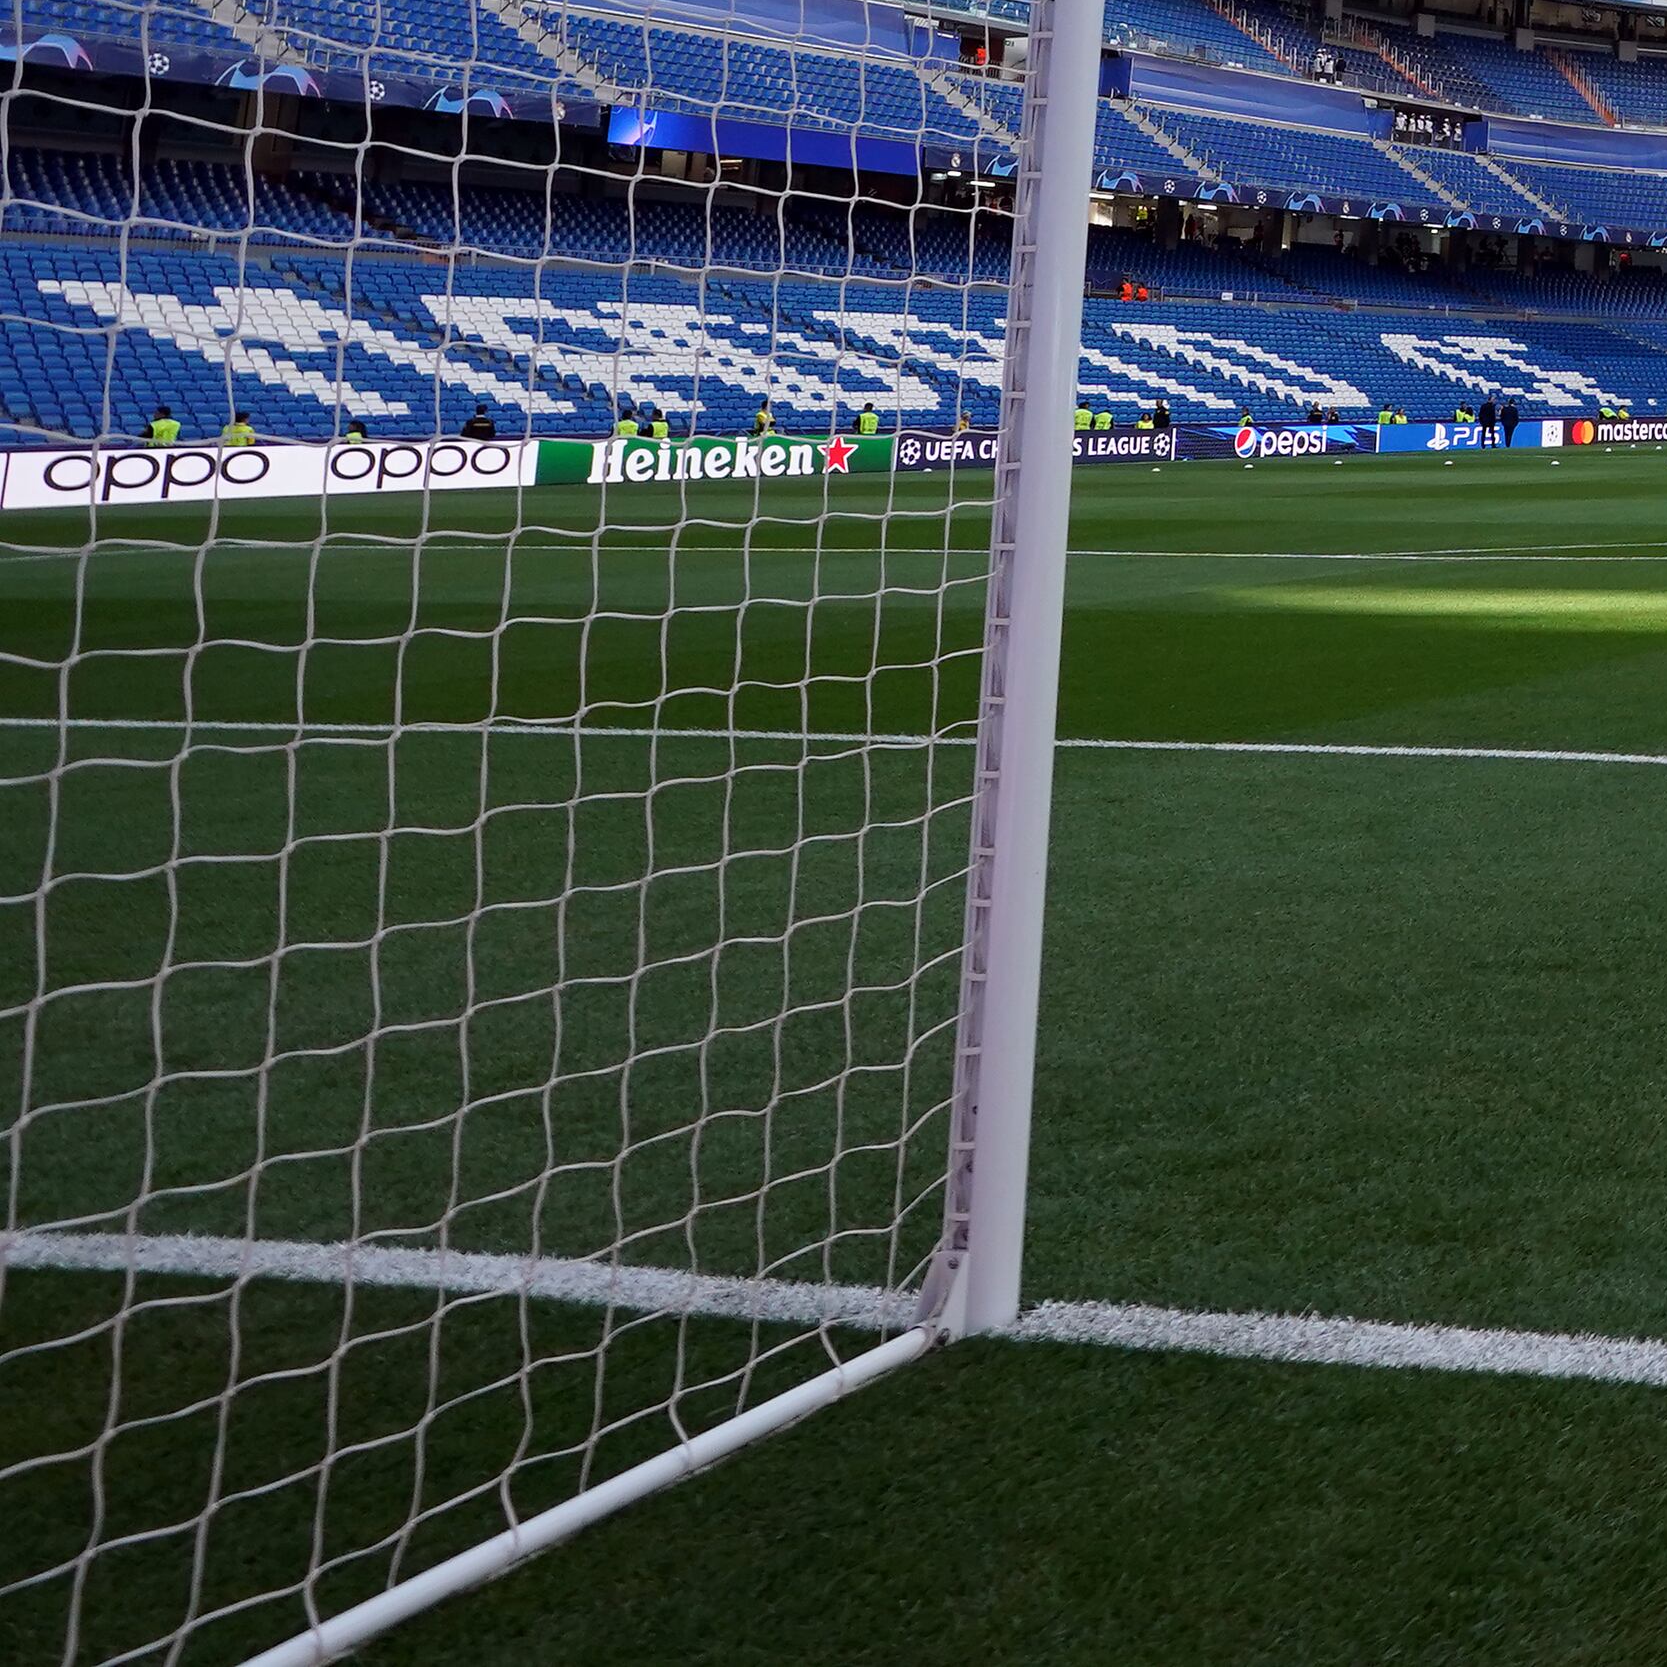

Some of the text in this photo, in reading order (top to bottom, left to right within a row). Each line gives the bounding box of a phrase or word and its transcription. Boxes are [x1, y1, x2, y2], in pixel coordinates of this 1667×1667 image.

[587, 436, 814, 484] Heineken
[925, 440, 975, 462] UEFA
[1088, 435, 1151, 456] LEAGUE
[1260, 425, 1328, 458] pepsi
[43, 449, 270, 501] oppo
[331, 443, 511, 490] oppo
